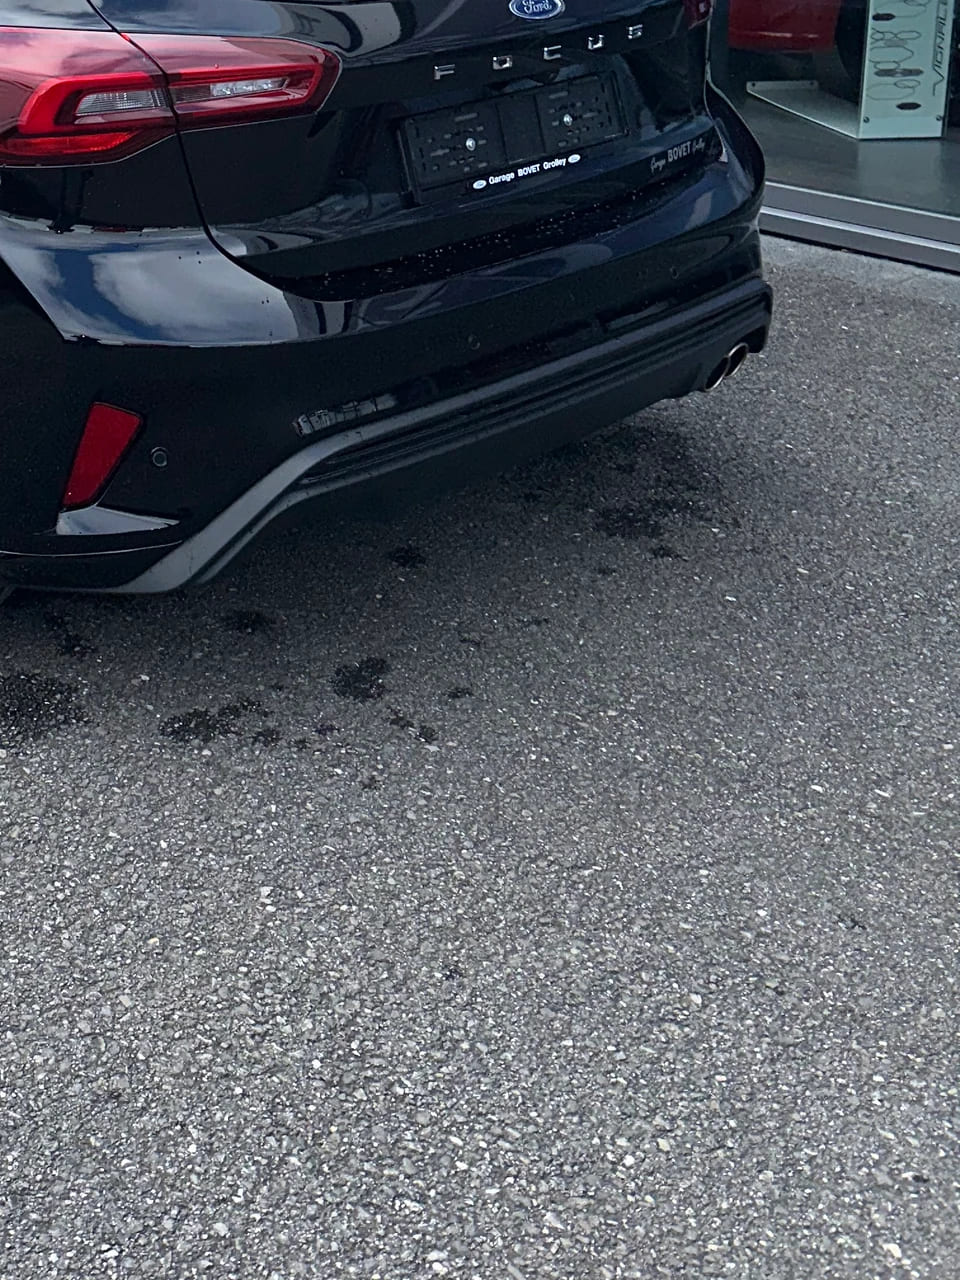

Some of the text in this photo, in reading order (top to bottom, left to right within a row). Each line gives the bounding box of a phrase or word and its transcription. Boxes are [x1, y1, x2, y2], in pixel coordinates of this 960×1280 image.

[434, 24, 643, 80] FOCUS
[667, 141, 692, 162] BOVET
[488, 171, 515, 185] Garage
[517, 163, 541, 177] BOVET
[543, 157, 567, 170] Grolley
